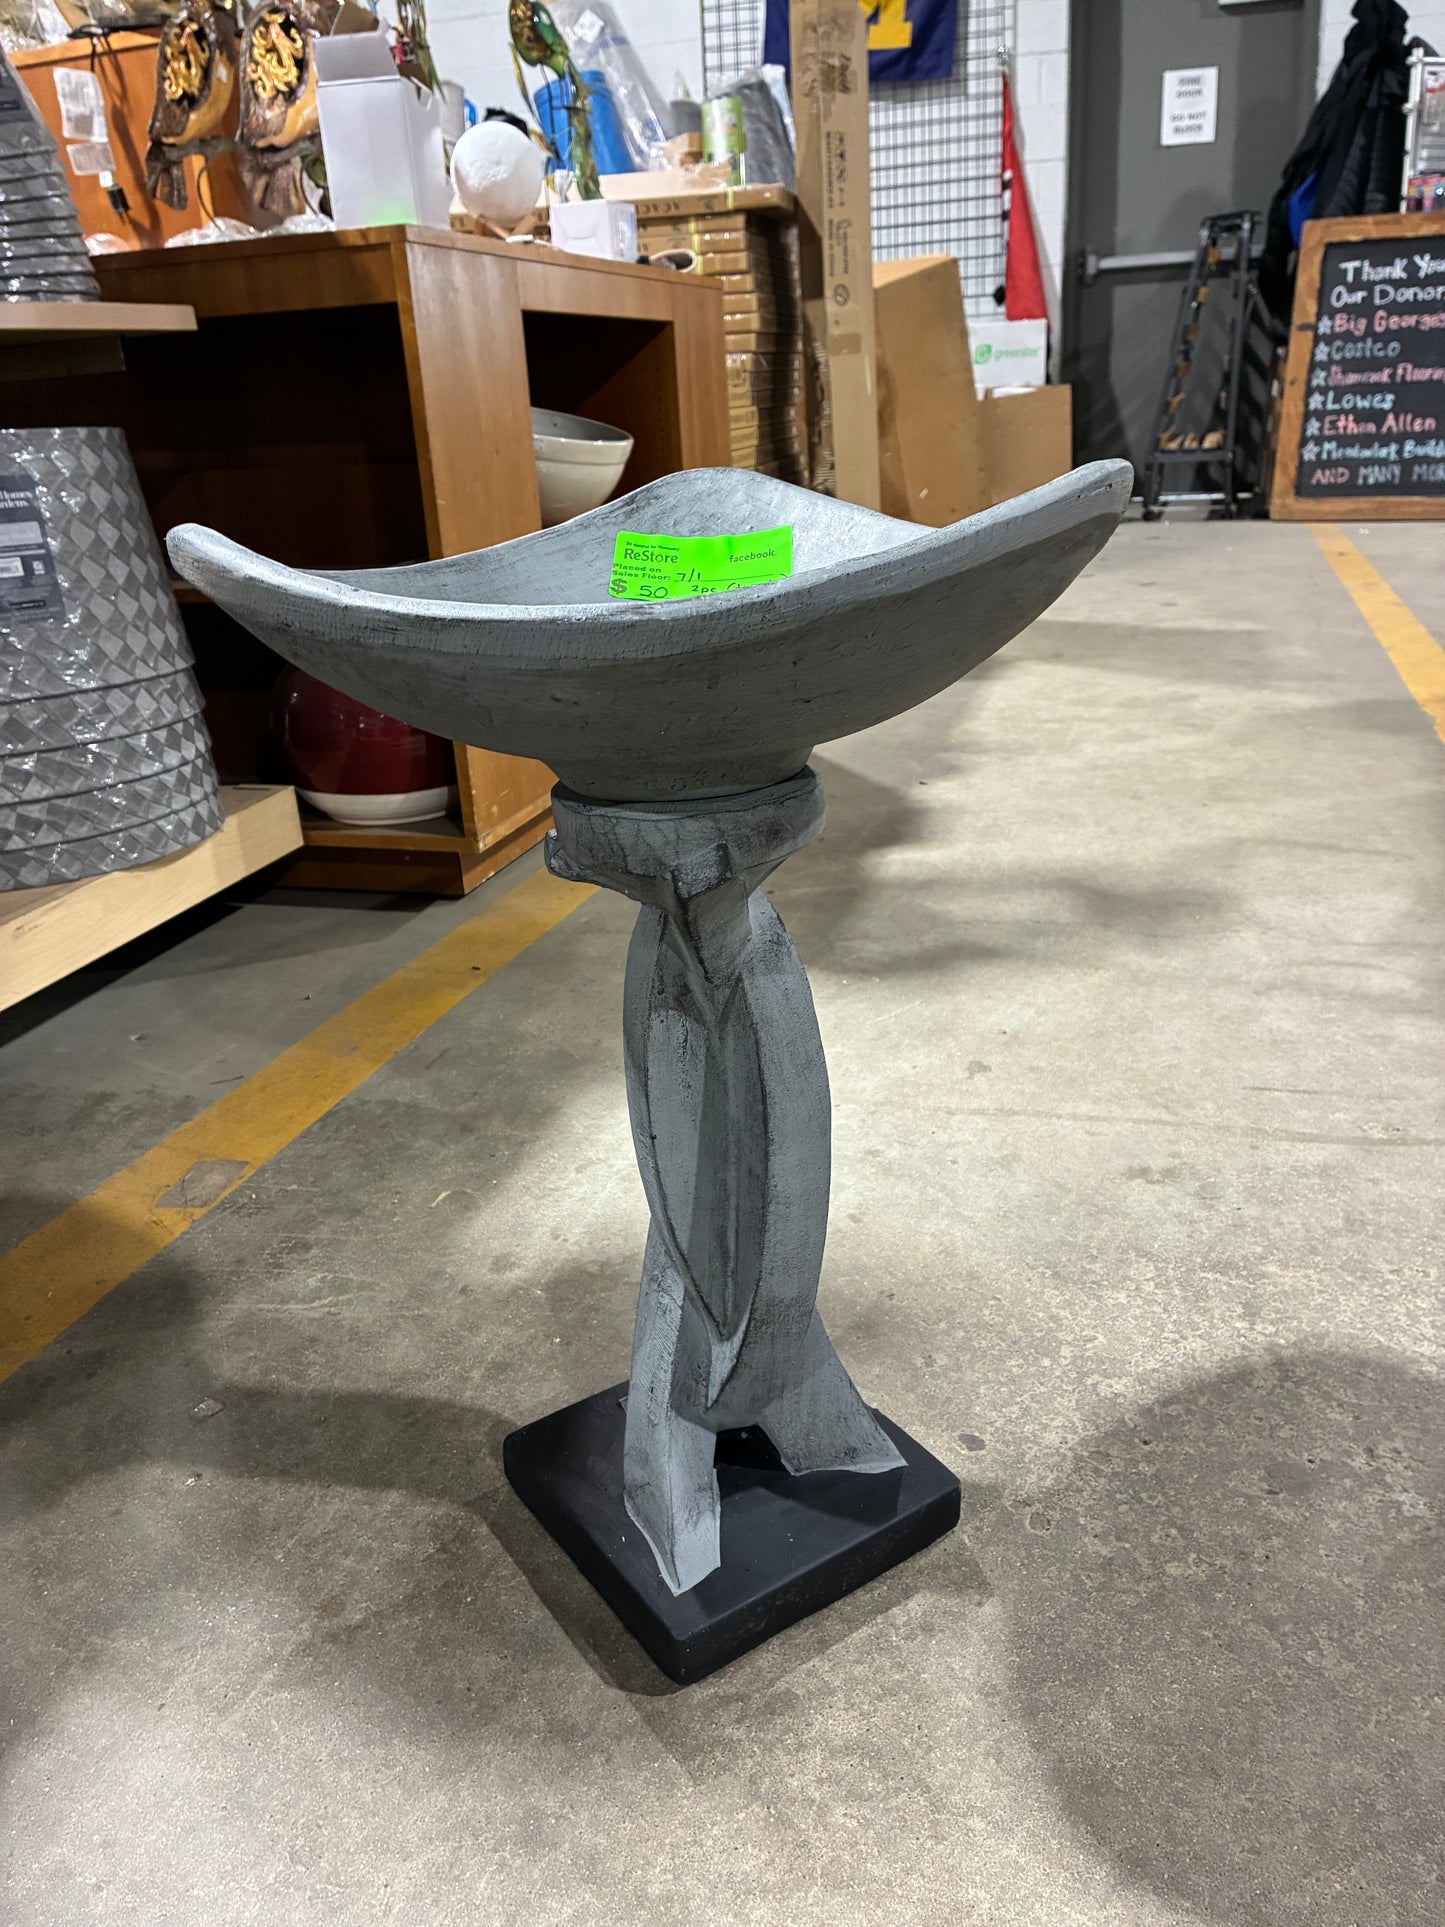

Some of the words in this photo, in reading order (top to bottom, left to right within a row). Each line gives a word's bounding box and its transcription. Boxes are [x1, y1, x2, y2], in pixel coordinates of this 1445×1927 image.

[1338, 257, 1409, 283] Thank
[1330, 285, 1368, 308] Our
[1332, 312, 1368, 337] Big
[1330, 337, 1401, 360] Costco
[1322, 413, 1377, 436] Ethan
[1381, 412, 1437, 434] Allen
[1311, 466, 1351, 485] AND
[1356, 463, 1401, 486] MANY
[623, 547, 679, 564] ReStore
[729, 549, 775, 563] facebook
[612, 570, 639, 578] Sales
[613, 563, 646, 572] Placed
[610, 578, 628, 595] $
[639, 585, 669, 599] 50
